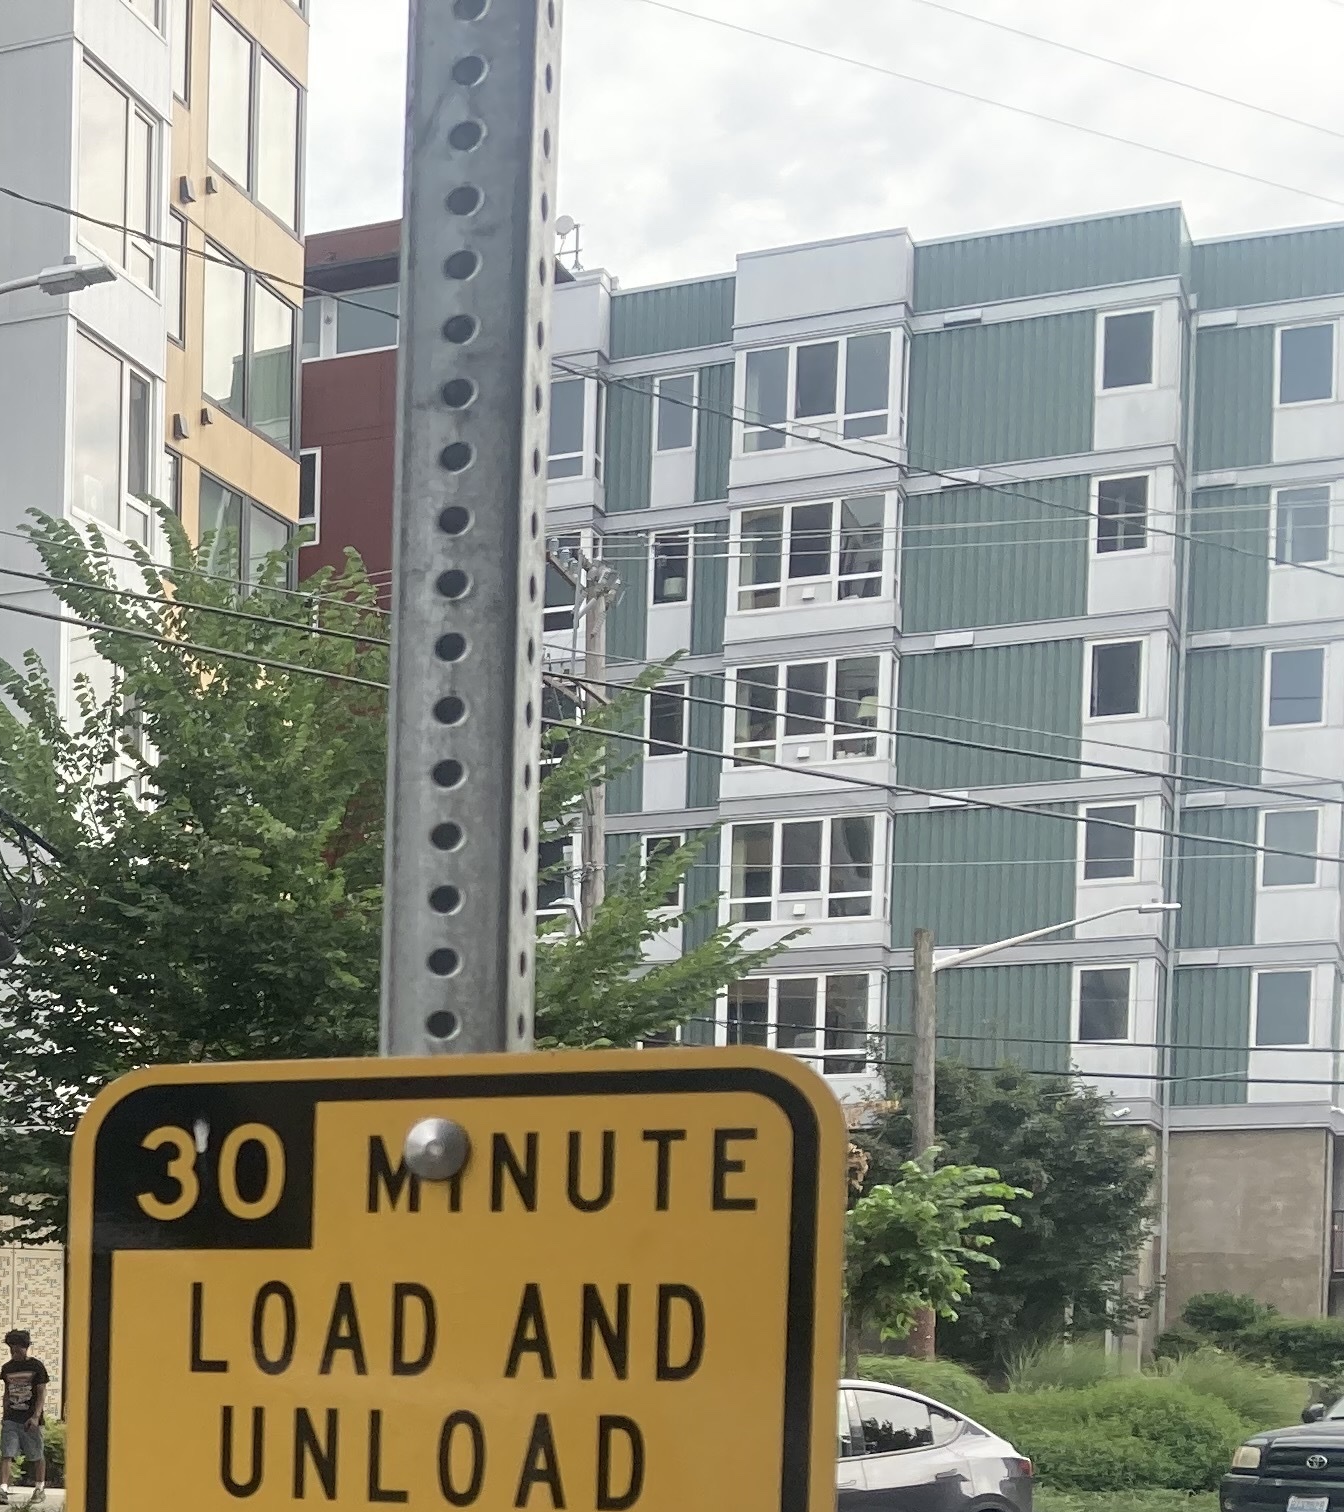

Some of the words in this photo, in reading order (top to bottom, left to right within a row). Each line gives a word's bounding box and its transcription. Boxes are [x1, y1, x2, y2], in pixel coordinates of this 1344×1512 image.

[135, 1122, 286, 1221] 30
[189, 1280, 438, 1376] LOAD
[505, 1283, 707, 1382] AND
[220, 1405, 646, 1512] UNLOAD
